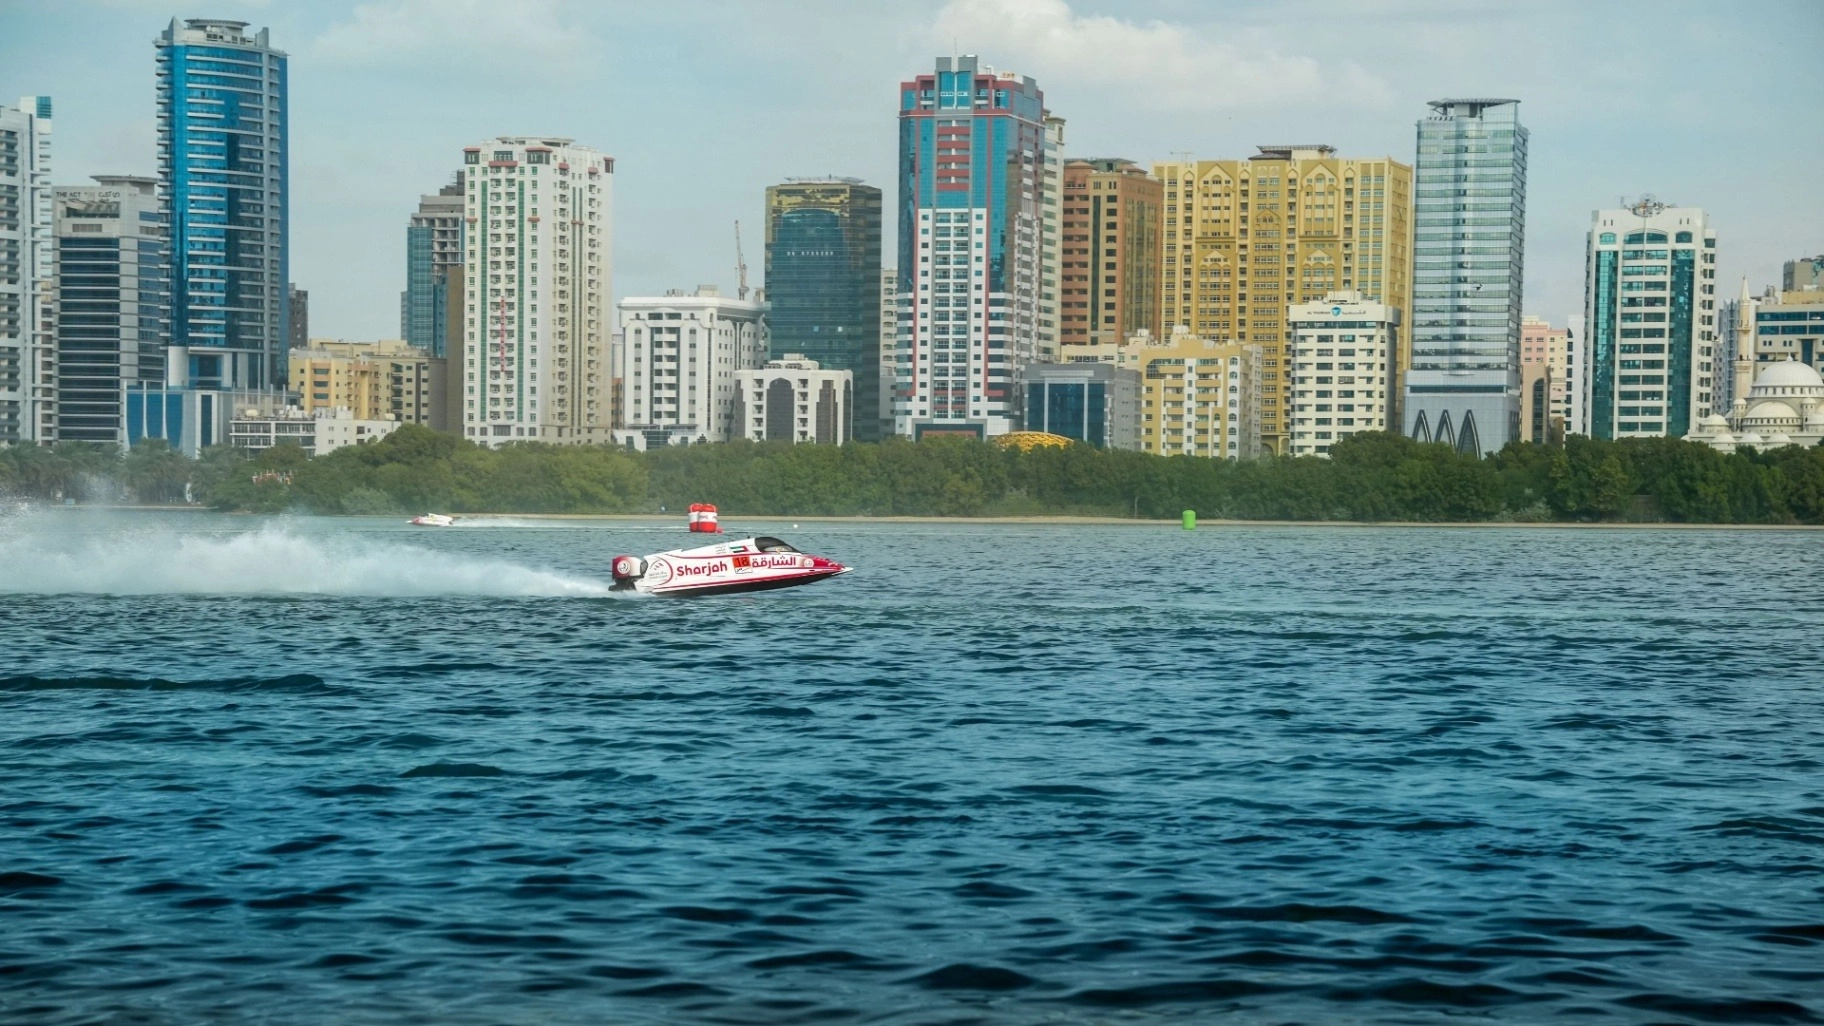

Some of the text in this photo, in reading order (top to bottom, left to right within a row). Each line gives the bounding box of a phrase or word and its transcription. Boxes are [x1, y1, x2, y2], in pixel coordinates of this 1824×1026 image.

[676, 560, 728, 577] Sharjah
[734, 556, 750, 568] 18
[752, 556, 796, 569] الشارقة
